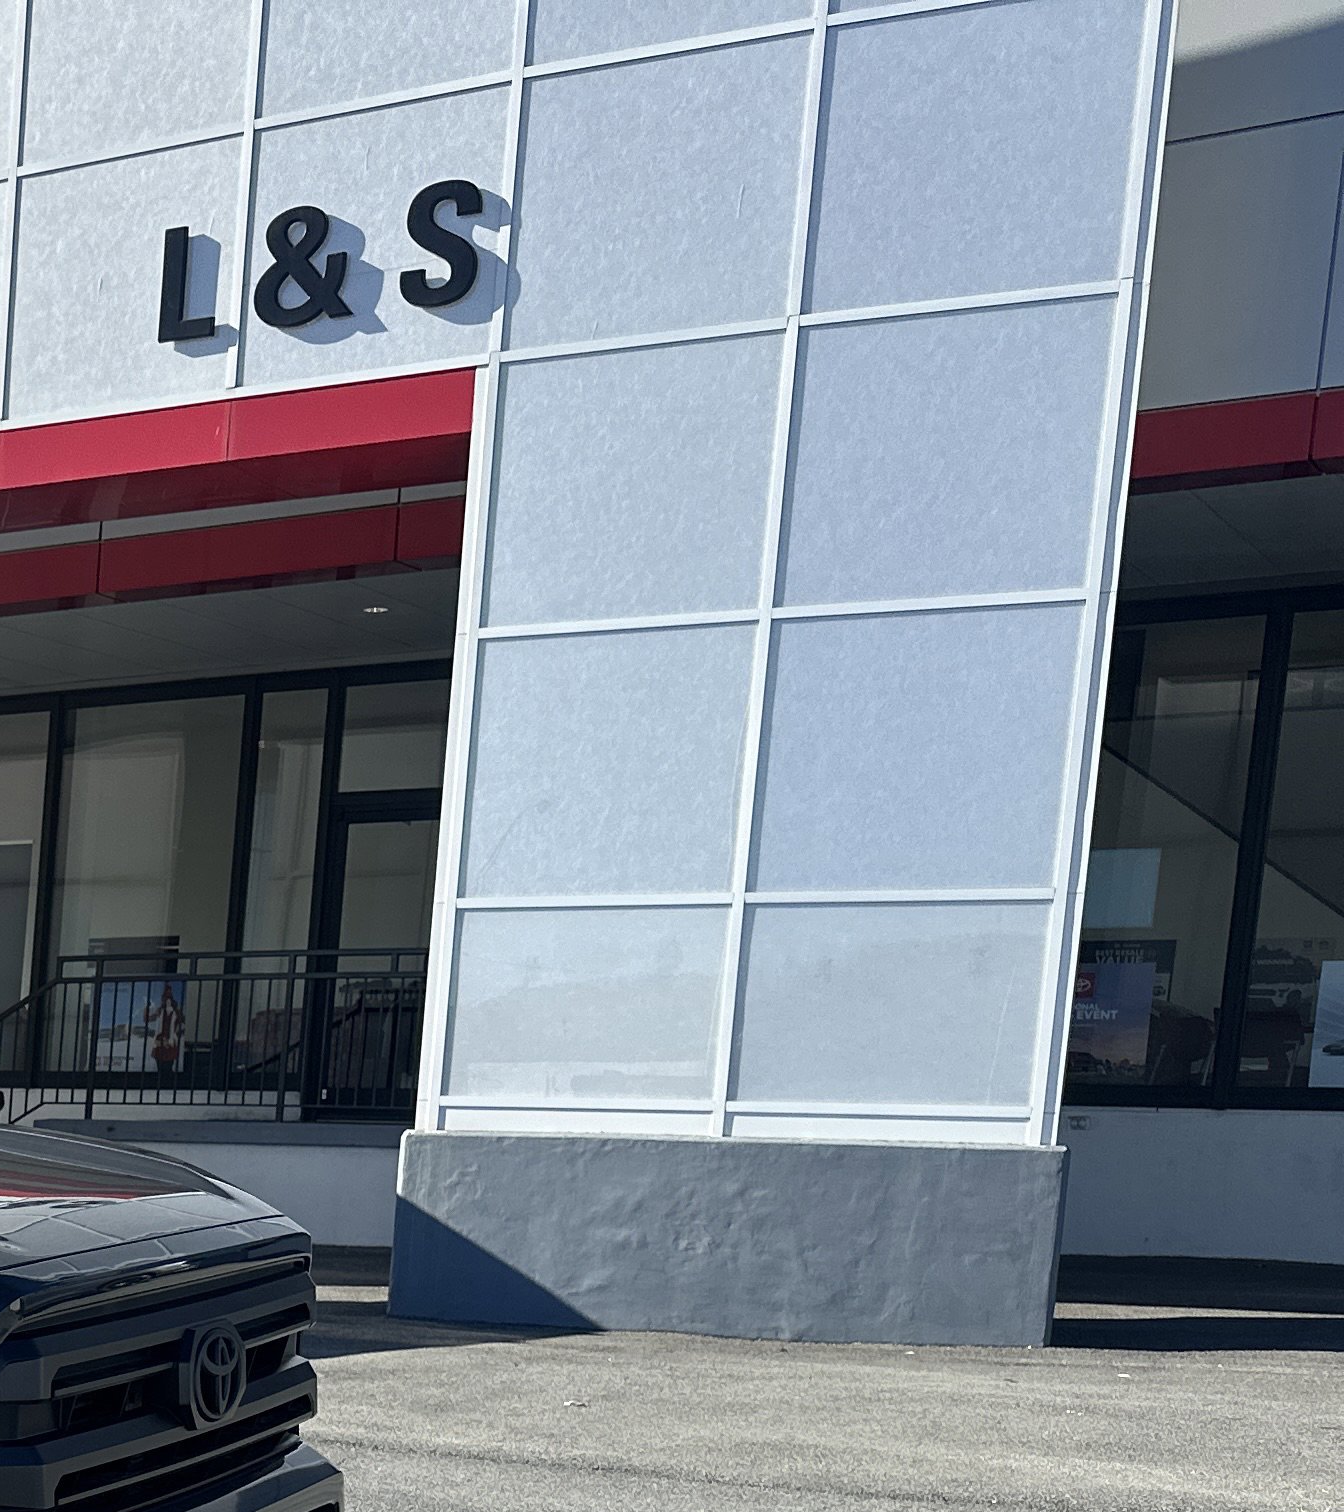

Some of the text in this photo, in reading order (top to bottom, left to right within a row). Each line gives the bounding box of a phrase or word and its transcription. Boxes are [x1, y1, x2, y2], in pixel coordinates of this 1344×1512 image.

[158, 179, 483, 343] L & S
[1076, 1009, 1119, 1020] EVENT
